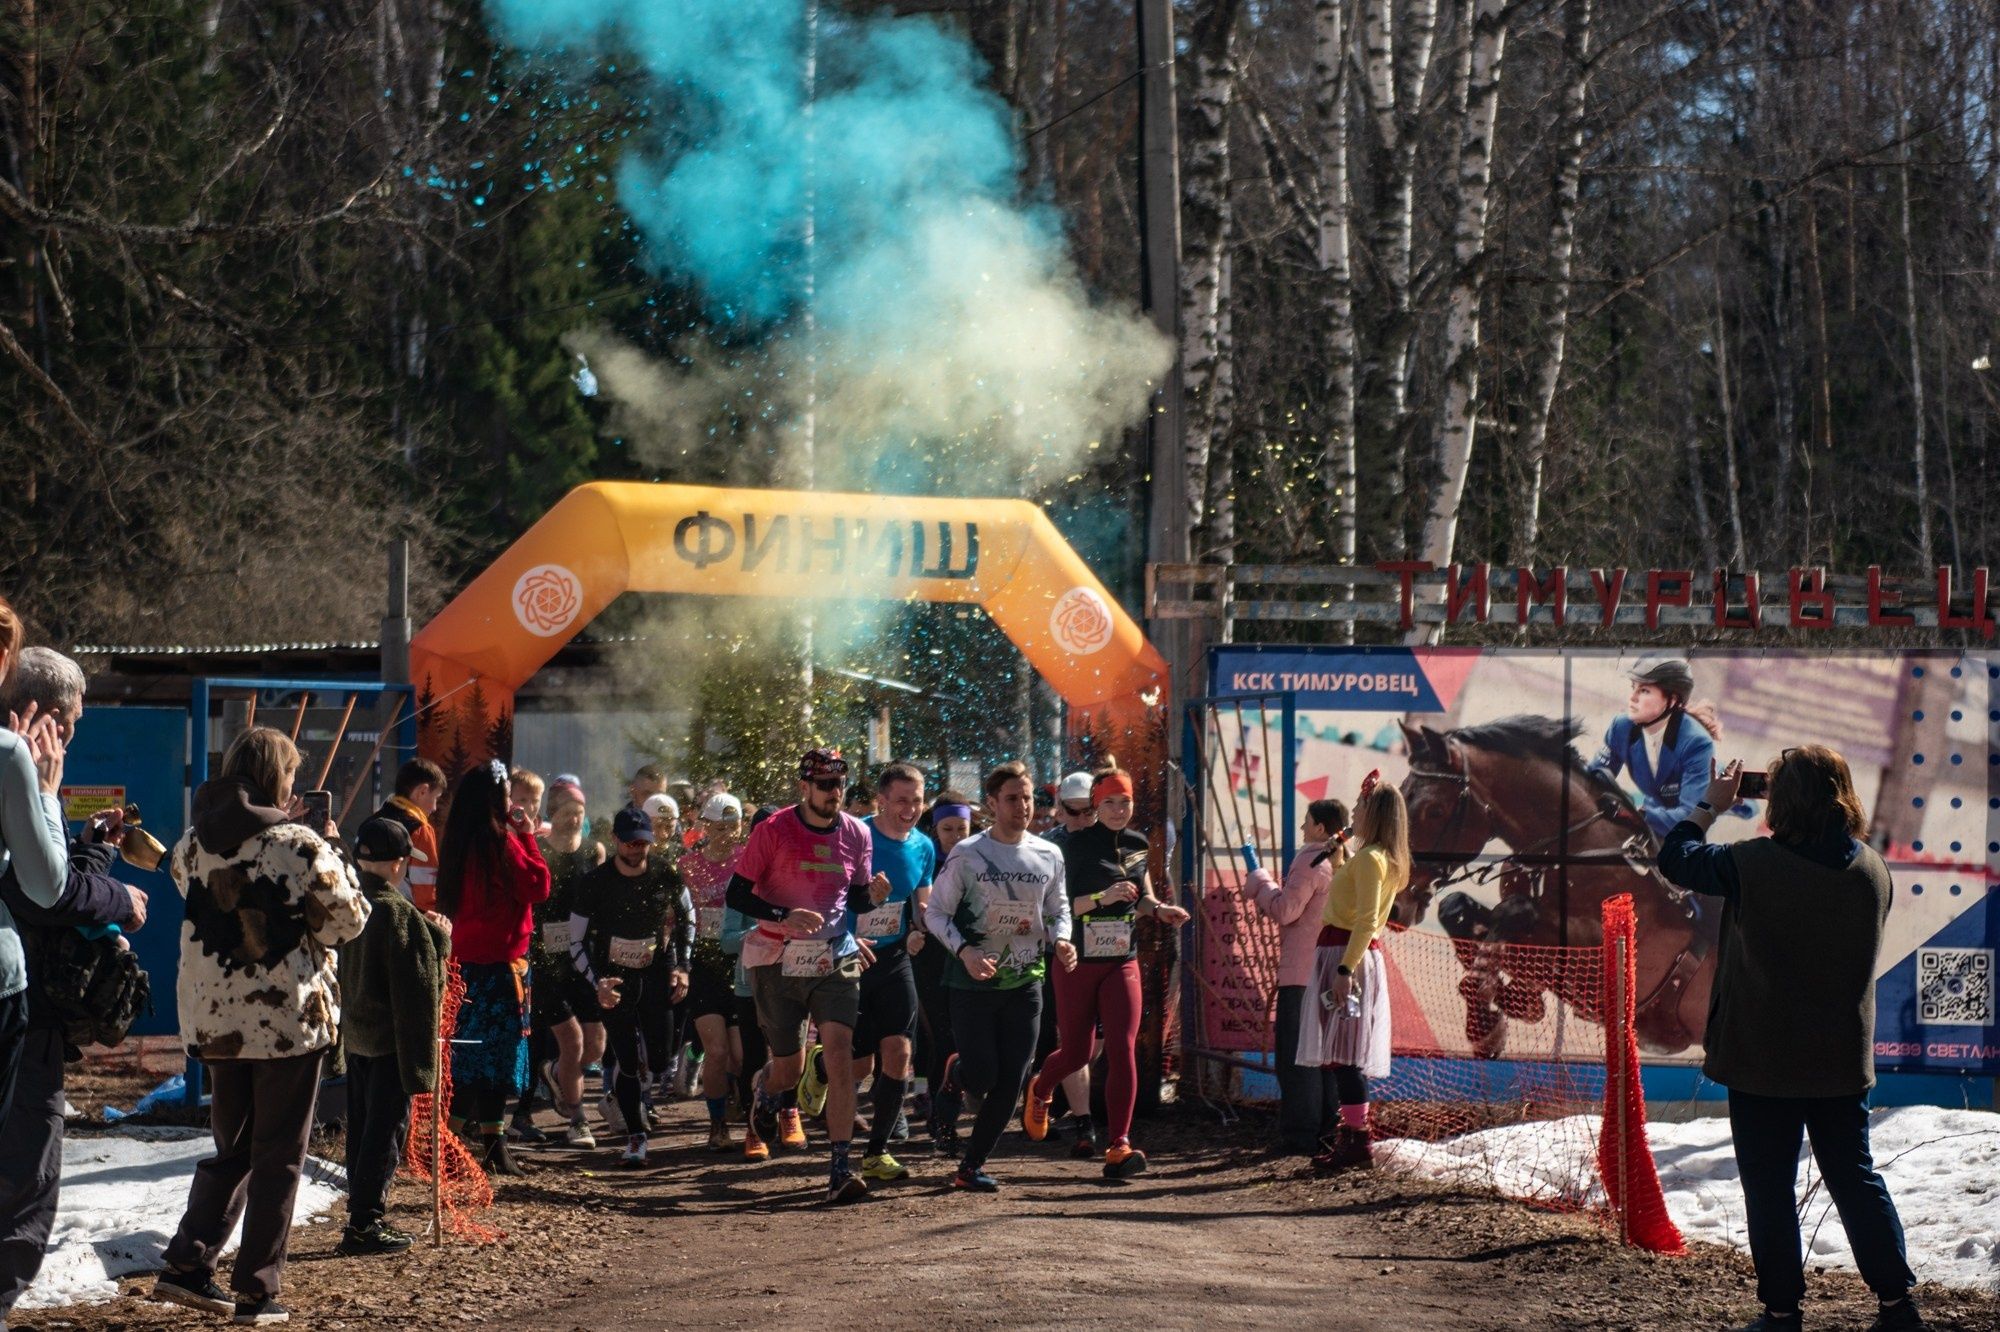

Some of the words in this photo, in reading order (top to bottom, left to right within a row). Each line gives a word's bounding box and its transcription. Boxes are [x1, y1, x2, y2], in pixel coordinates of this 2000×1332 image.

[672, 509, 980, 580] ФИНИШ
[1233, 673, 1275, 691] КСК
[1280, 673, 1419, 697] ТИМУРОВЕЦ
[975, 871, 1050, 885] VLADYKINO
[870, 917, 889, 927] 1541
[998, 915, 1020, 926] 1510
[1095, 935, 1117, 946] 1508
[1873, 1041, 1921, 1057] 91299
